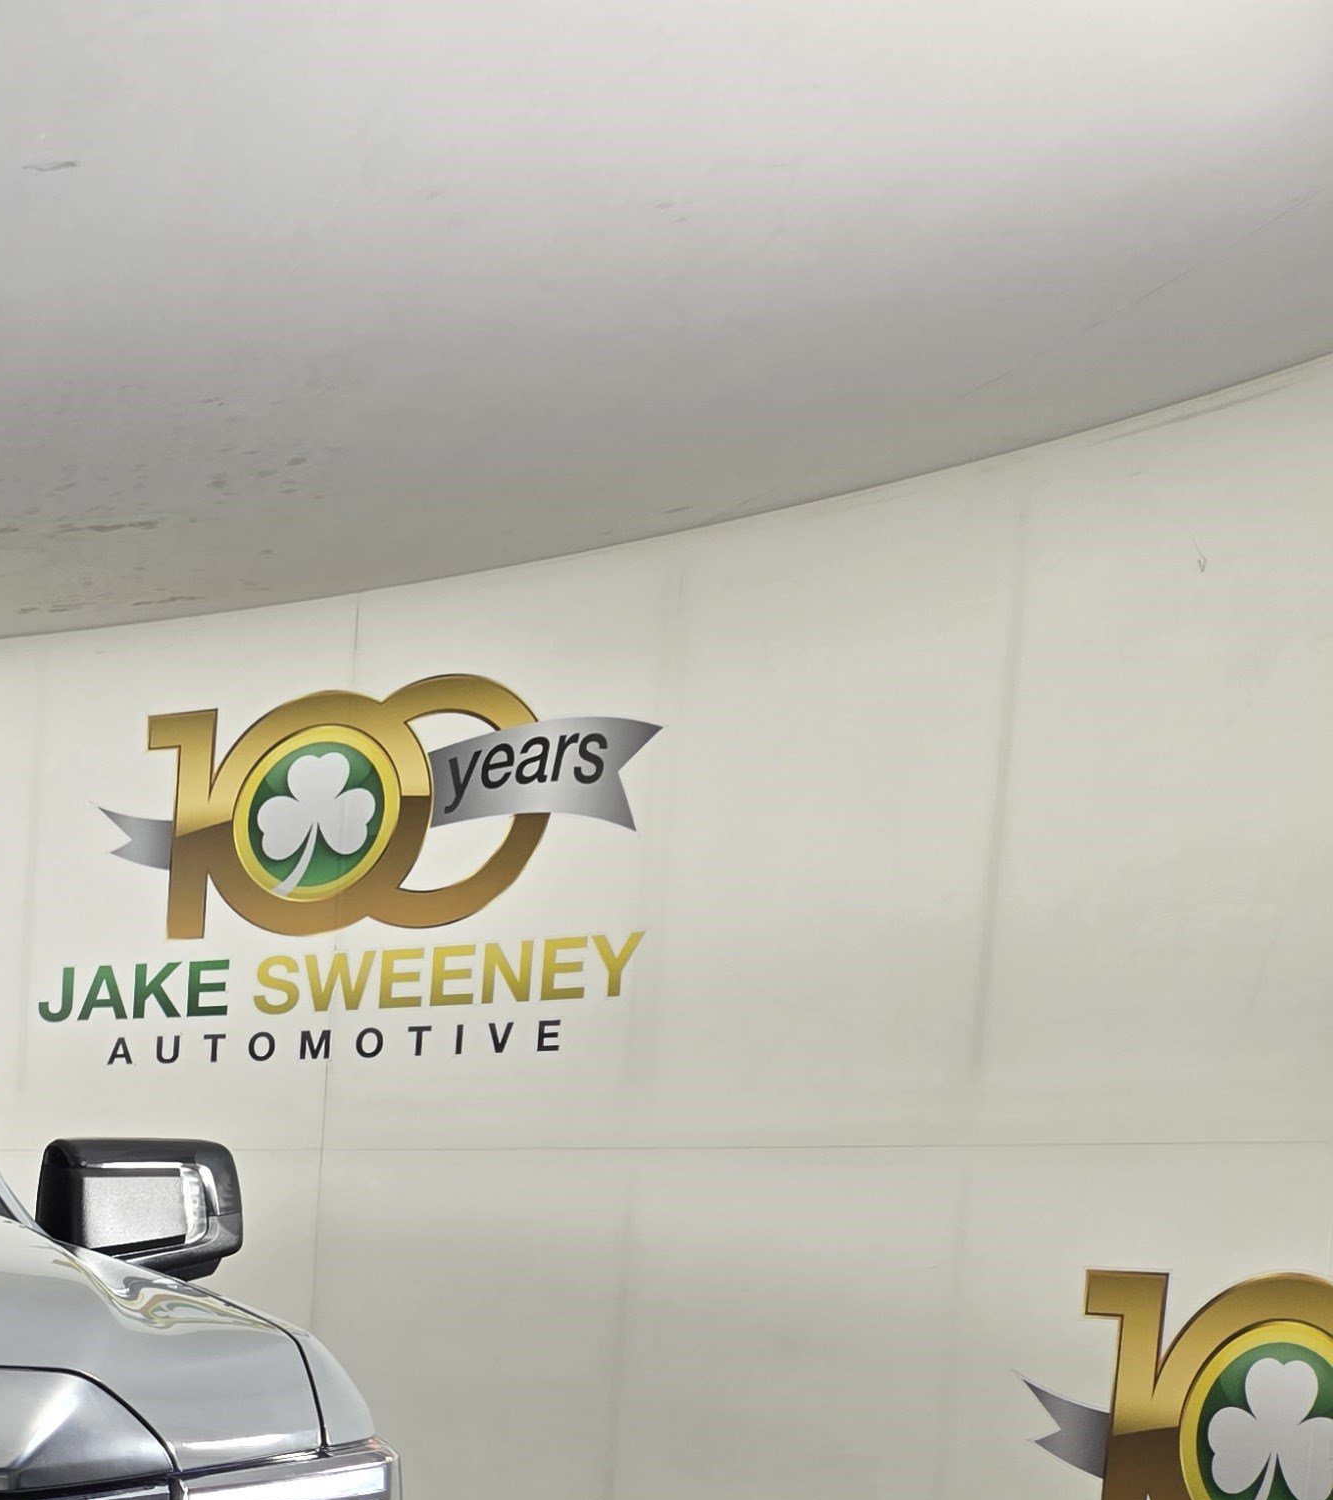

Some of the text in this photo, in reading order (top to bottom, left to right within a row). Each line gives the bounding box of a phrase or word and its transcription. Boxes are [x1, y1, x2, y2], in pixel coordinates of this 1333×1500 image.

[147, 674, 552, 940] 100
[444, 730, 608, 814] years
[38, 931, 646, 1024] JAKE SWEENEY
[107, 1020, 562, 1066] AUTOMOTIVE
